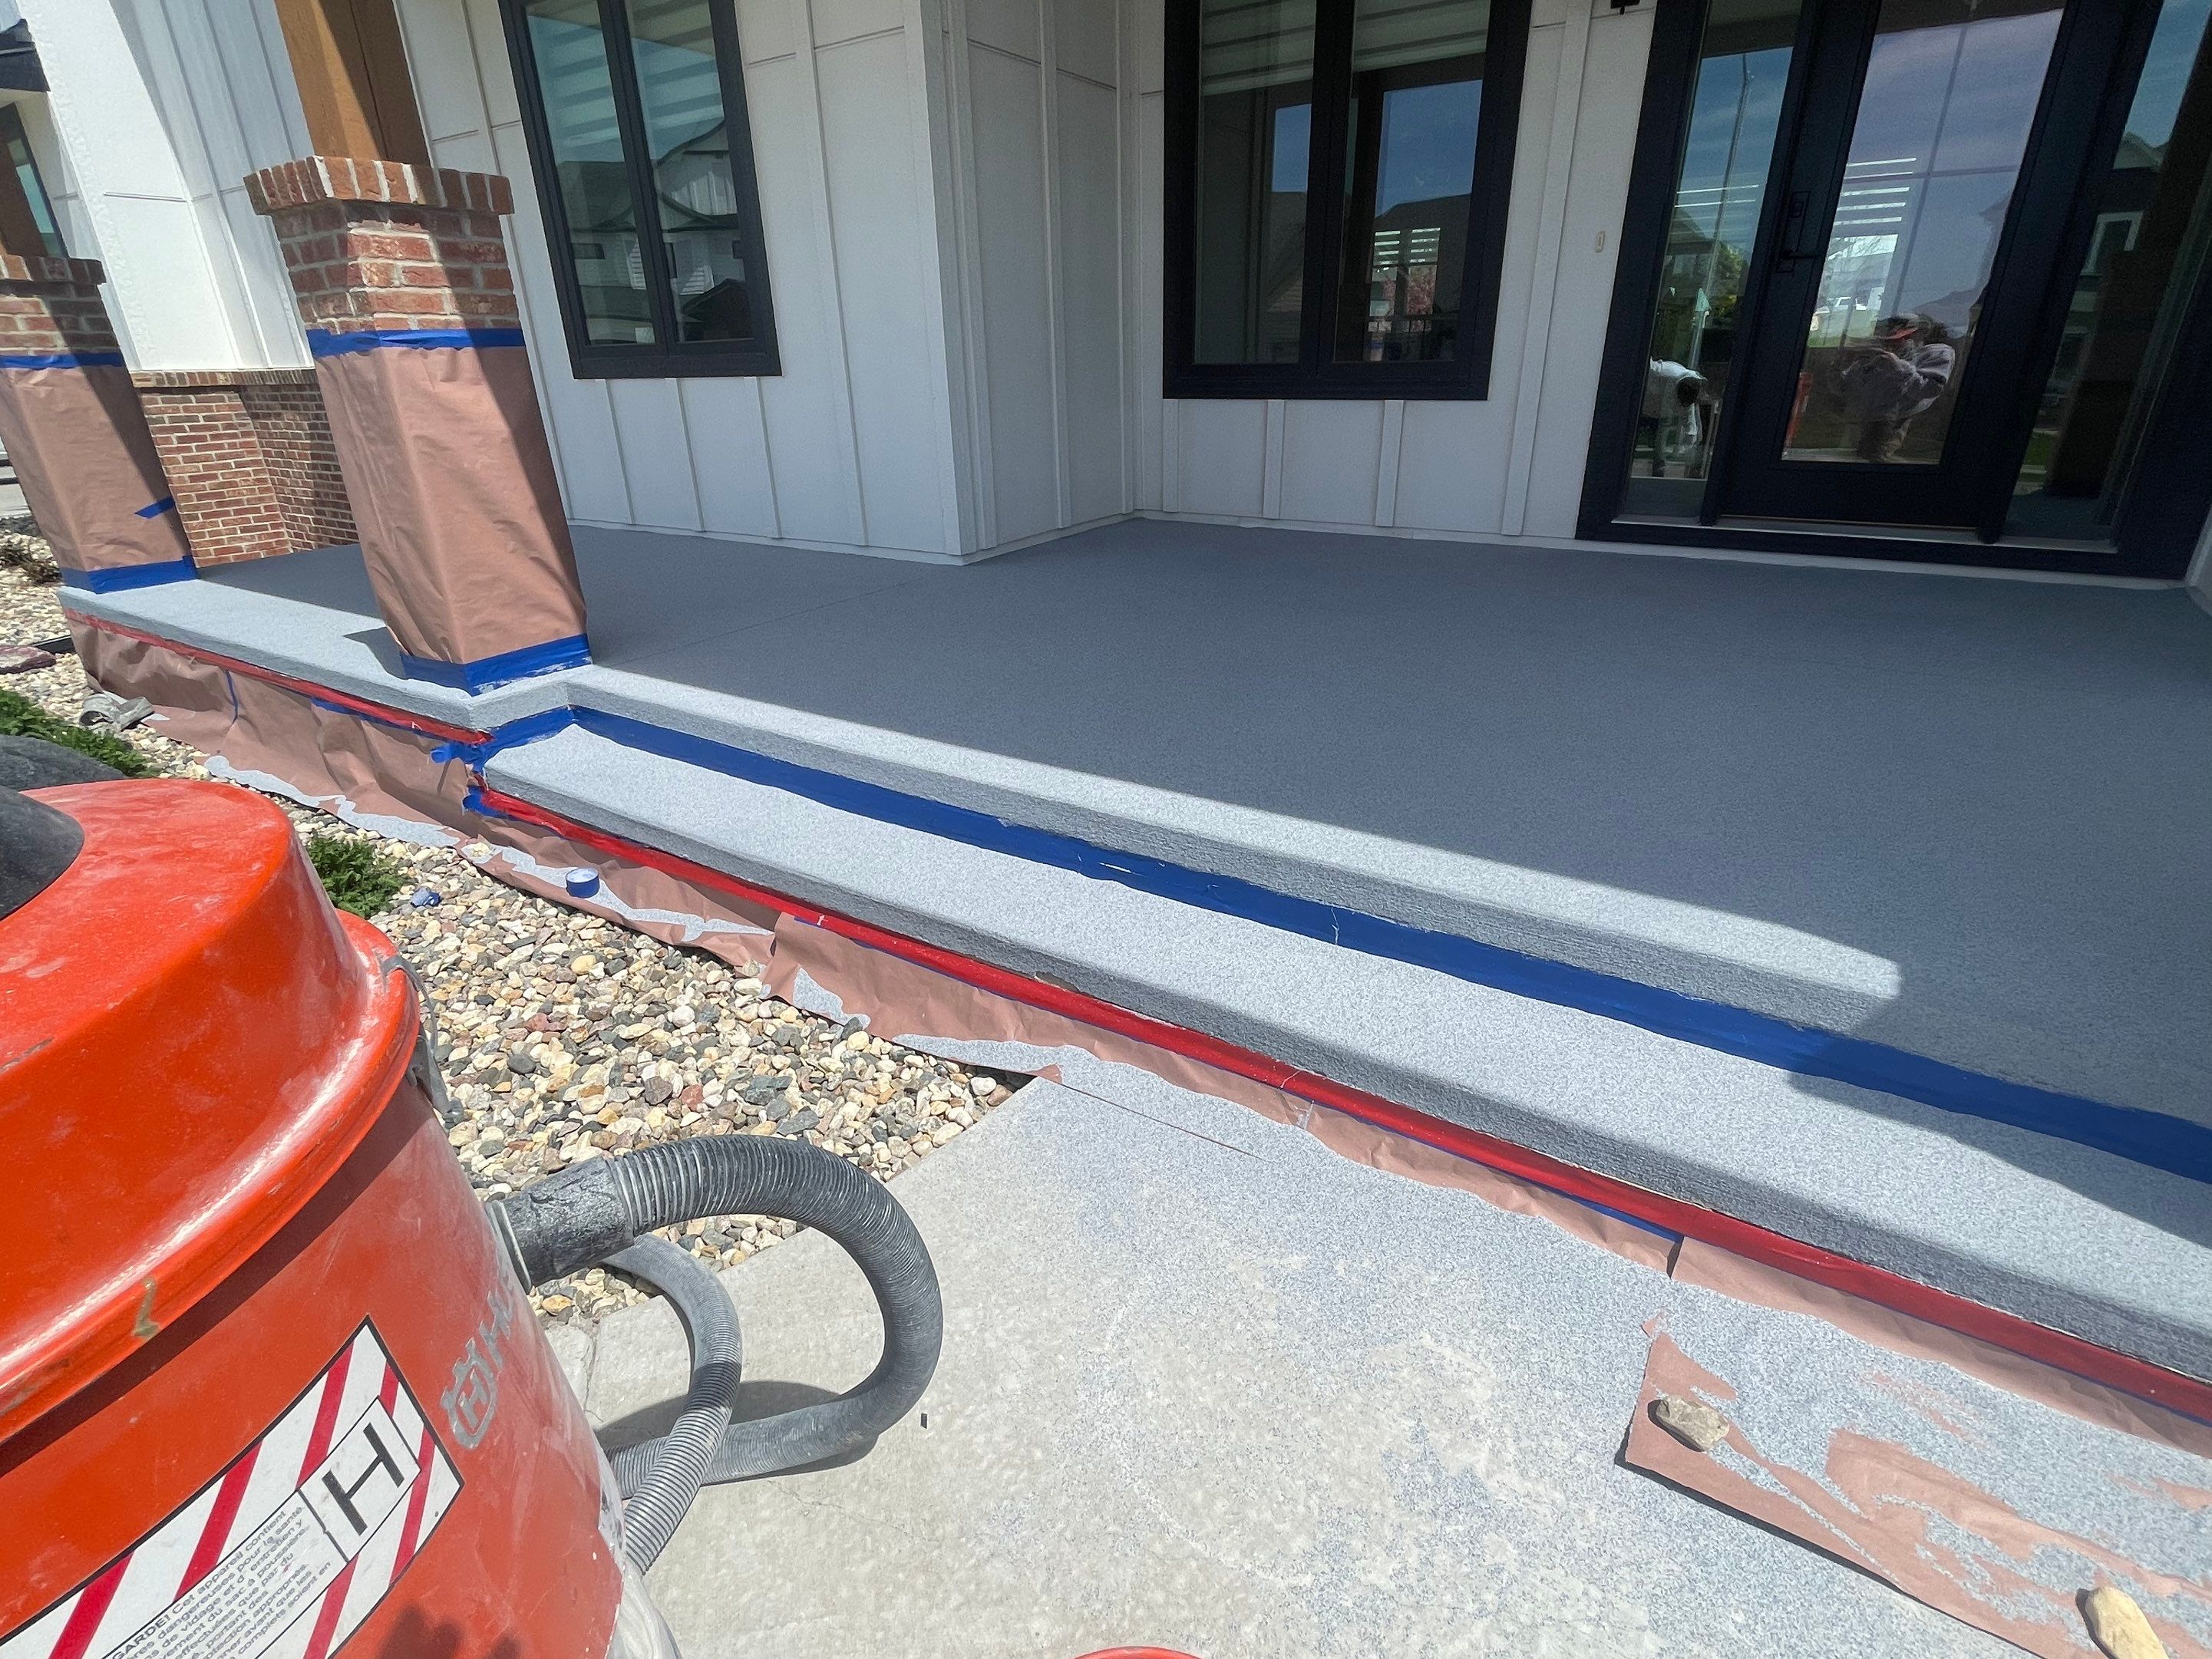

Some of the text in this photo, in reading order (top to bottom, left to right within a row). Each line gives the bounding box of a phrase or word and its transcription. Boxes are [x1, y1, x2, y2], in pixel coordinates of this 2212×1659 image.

[321, 1421, 405, 1537] H
[113, 1510, 286, 1659] GARDE! Cet appareil contient
[157, 1573, 236, 1639] dangereuses
[237, 1546, 262, 1572] pour
[262, 1535, 274, 1546] la
[162, 1634, 178, 1648] de
[180, 1597, 221, 1631] vidage
[223, 1583, 236, 1596] et
[250, 1527, 295, 1572] entretien
[295, 1519, 302, 1529] y
[205, 1609, 247, 1649] portant
[249, 1590, 269, 1610] des
[207, 1608, 223, 1622] du
[225, 1587, 246, 1607] sac
[238, 1586, 259, 1607] que
[262, 1567, 279, 1587] par
[280, 1552, 294, 1567] du
[238, 1561, 332, 1655] complets soient en
[244, 1607, 275, 1638] avant
[276, 1588, 295, 1608] que
[296, 1569, 312, 1587] les
